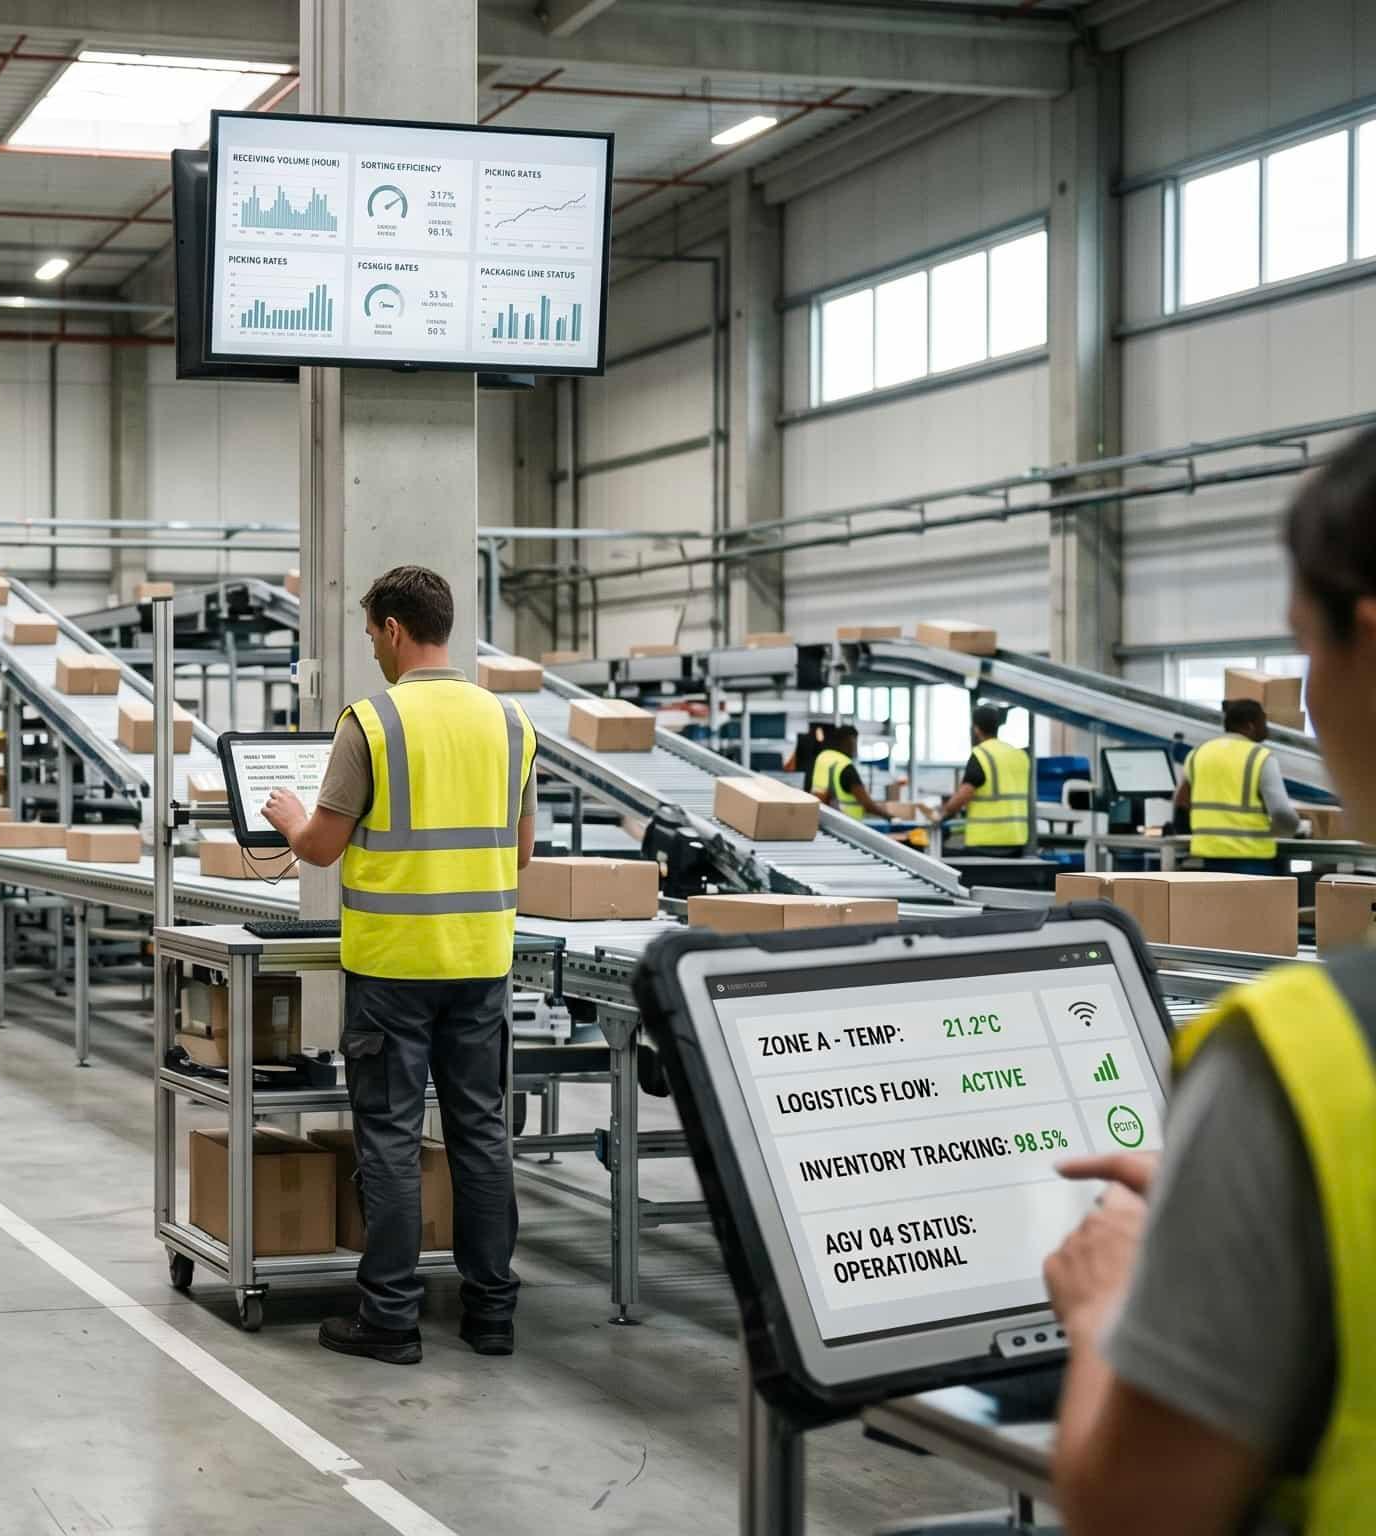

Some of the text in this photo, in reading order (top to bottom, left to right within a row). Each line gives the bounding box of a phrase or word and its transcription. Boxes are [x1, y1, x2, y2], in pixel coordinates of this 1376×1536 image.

[232, 153, 340, 168] RECEIVING VOLUME (HOUR)
[360, 160, 441, 173] SORTING EFFICIENCY
[484, 168, 542, 179] PICKING RATES
[228, 255, 288, 266] PICKING RATES
[480, 267, 576, 280] PACKAGING LINE STATUS
[758, 1033, 812, 1057] ZONE
[817, 1032, 831, 1051] A
[844, 1025, 904, 1048] TEMP:
[942, 1014, 1002, 1038] 21.2°C
[776, 1068, 1026, 1114] LOGISTICS FLOW: ACTIVE
[799, 1129, 1069, 1182] INVENTORY TRACKING: 98.5%
[825, 1215, 977, 1255] AGV 04 STATUS:
[833, 1246, 968, 1283] OPERATIONAL
